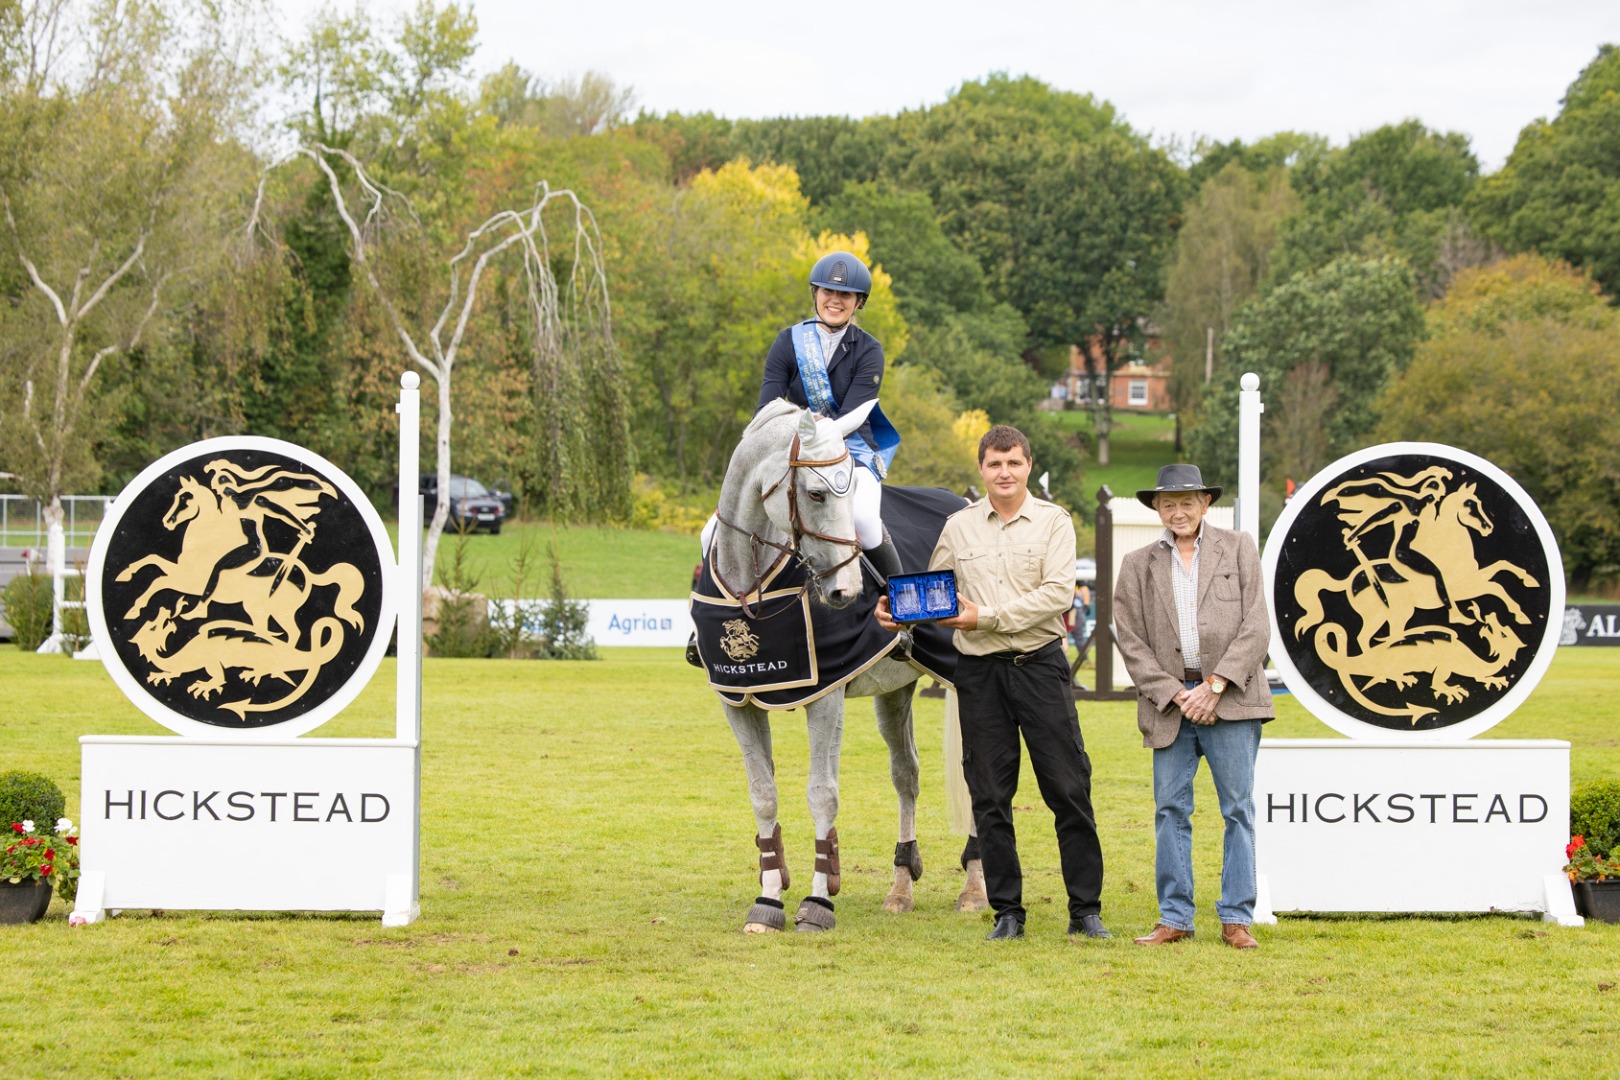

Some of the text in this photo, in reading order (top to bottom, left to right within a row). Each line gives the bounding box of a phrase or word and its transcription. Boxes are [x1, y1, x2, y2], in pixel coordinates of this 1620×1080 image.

[608, 613, 658, 635] Agria
[712, 660, 788, 675] HICKSTEAD
[104, 789, 391, 823] HICKSTEAD
[1266, 793, 1549, 824] HICKSTEAD
